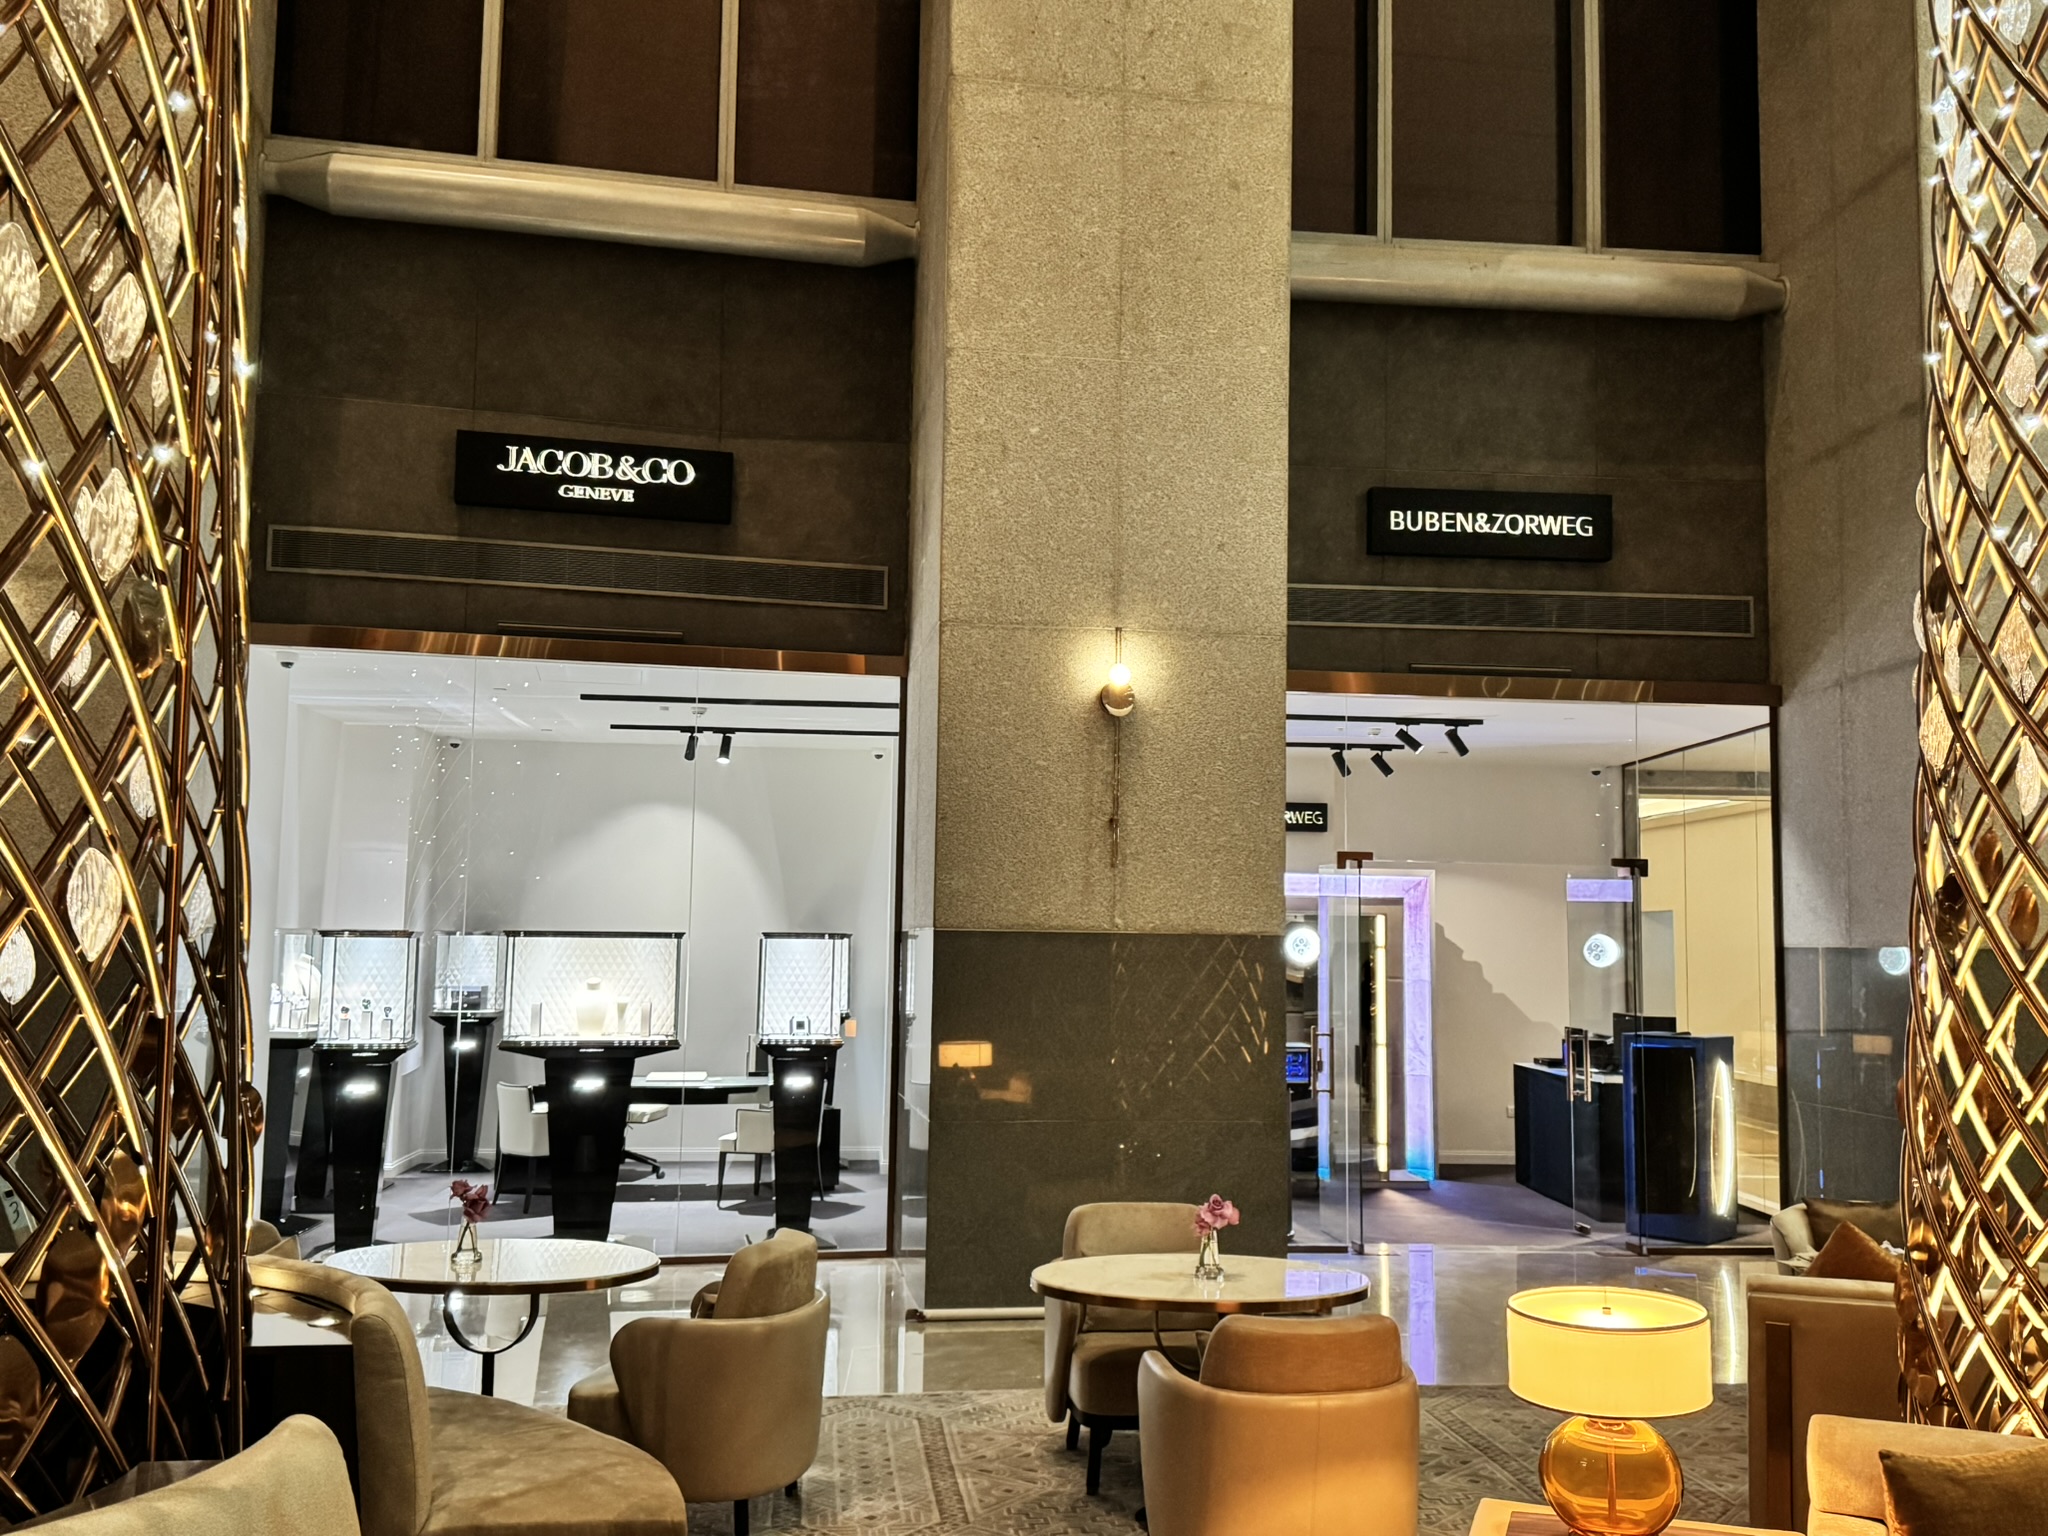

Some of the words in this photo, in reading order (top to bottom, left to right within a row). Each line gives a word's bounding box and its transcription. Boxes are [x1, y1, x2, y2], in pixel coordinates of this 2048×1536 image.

[496, 445, 697, 487] JACOB&CO
[557, 484, 635, 503] GENEVE
[1389, 510, 1594, 537] BUBEN&ZORWEG
